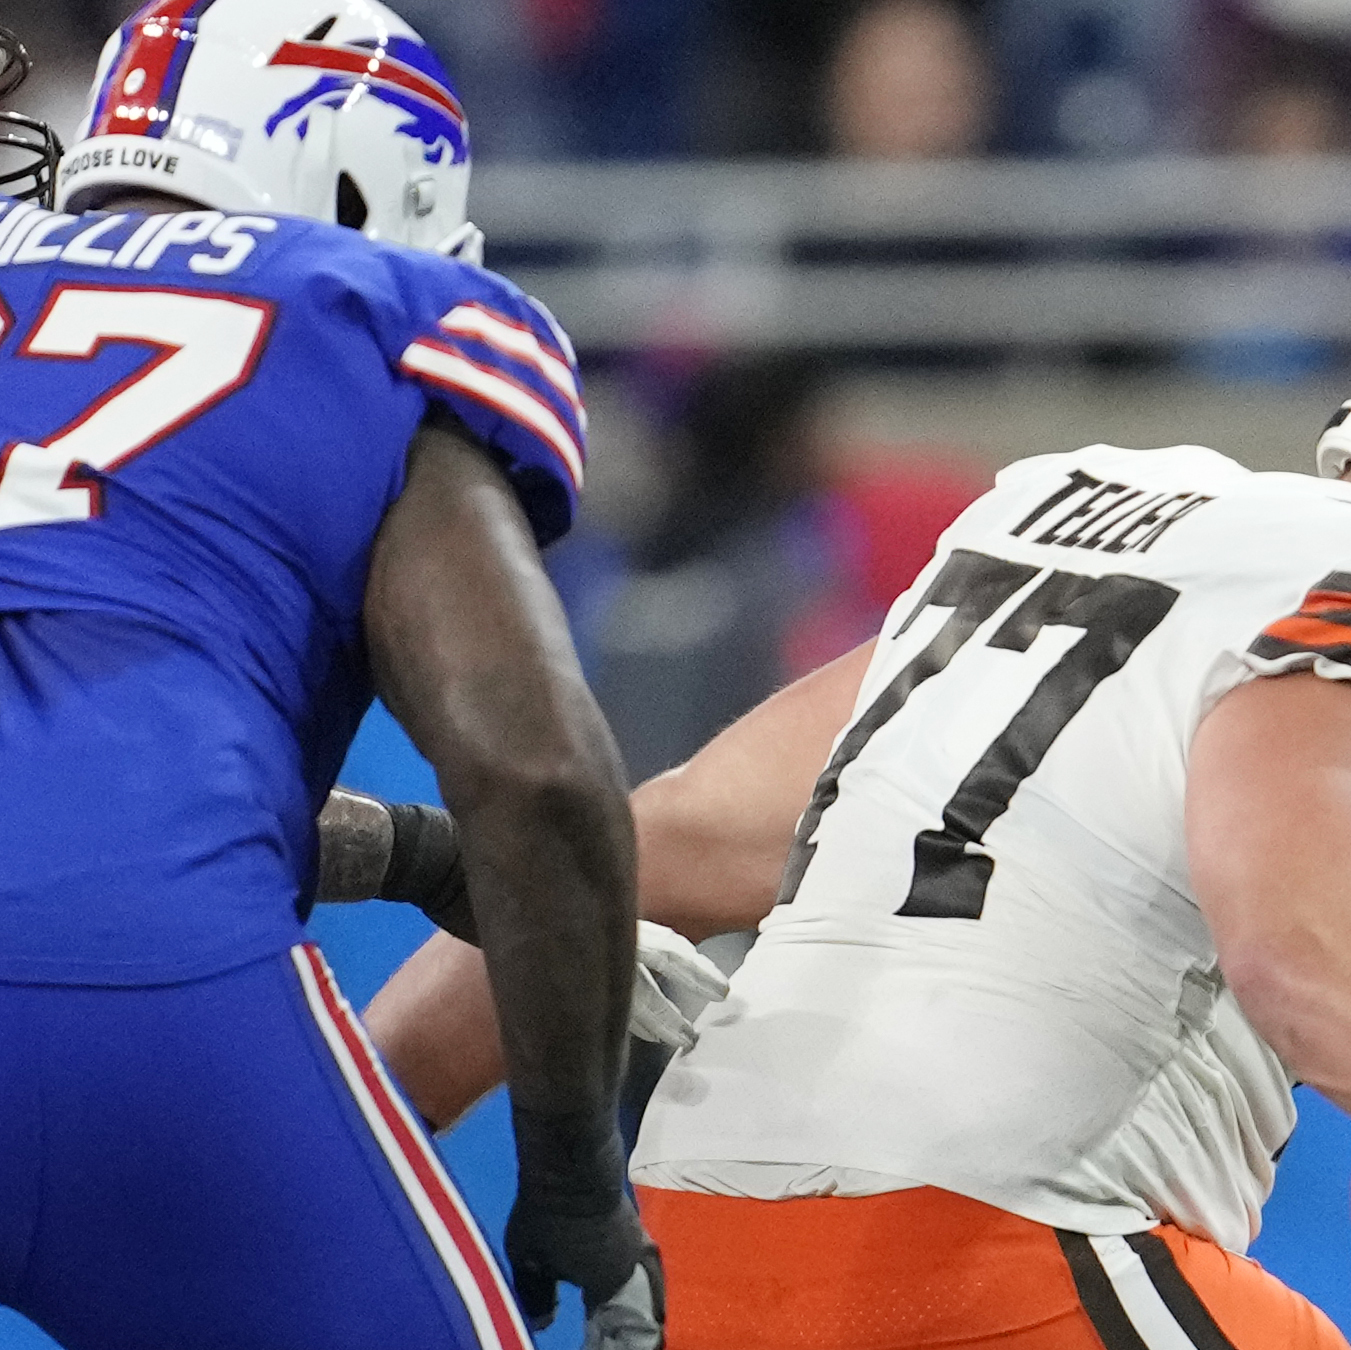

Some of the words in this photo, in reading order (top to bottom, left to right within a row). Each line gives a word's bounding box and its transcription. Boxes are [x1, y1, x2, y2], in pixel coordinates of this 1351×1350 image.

[120, 147, 179, 175] LOVE
[0, 280, 279, 529] 7
[1008, 468, 1219, 554] TELLER
[774, 547, 1182, 921] 77
